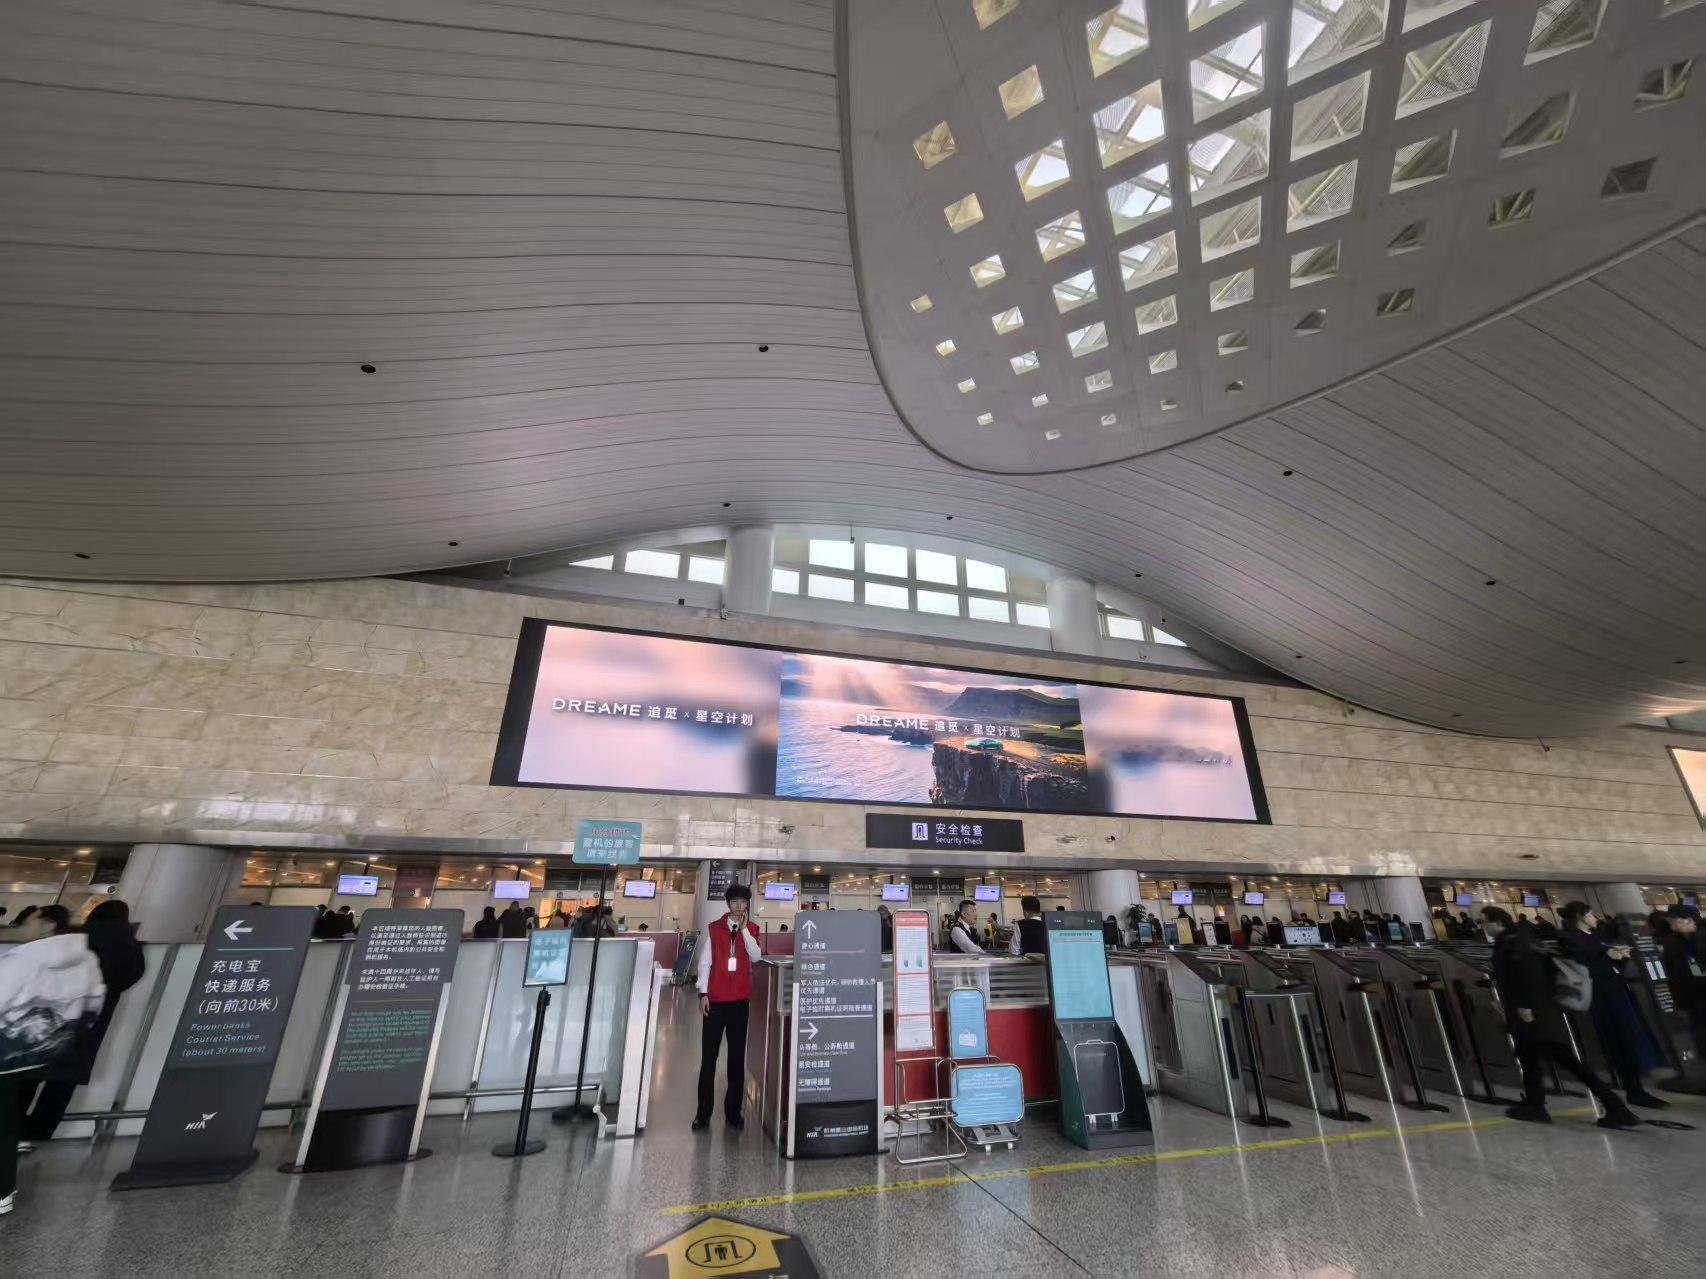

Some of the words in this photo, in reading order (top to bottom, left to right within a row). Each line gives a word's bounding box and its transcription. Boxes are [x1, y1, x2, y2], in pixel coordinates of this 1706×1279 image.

[551, 697, 642, 717] DREAME
[647, 705, 678, 720] 追觅
[695, 709, 754, 727] 星空计划
[855, 713, 929, 731] DREAME
[934, 721, 958, 733] 追觅
[973, 723, 1021, 739] 星空计划
[935, 823, 983, 837] 安全检查
[935, 836, 962, 845] Security
[963, 837, 983, 845] Check
[210, 959, 262, 974] 充电宝
[203, 979, 272, 994] 快递服务
[190, 1022, 222, 1032] Power
[186, 1035, 223, 1045] Courier
[224, 1033, 260, 1042] Service
[216, 1047, 227, 1055] 30
